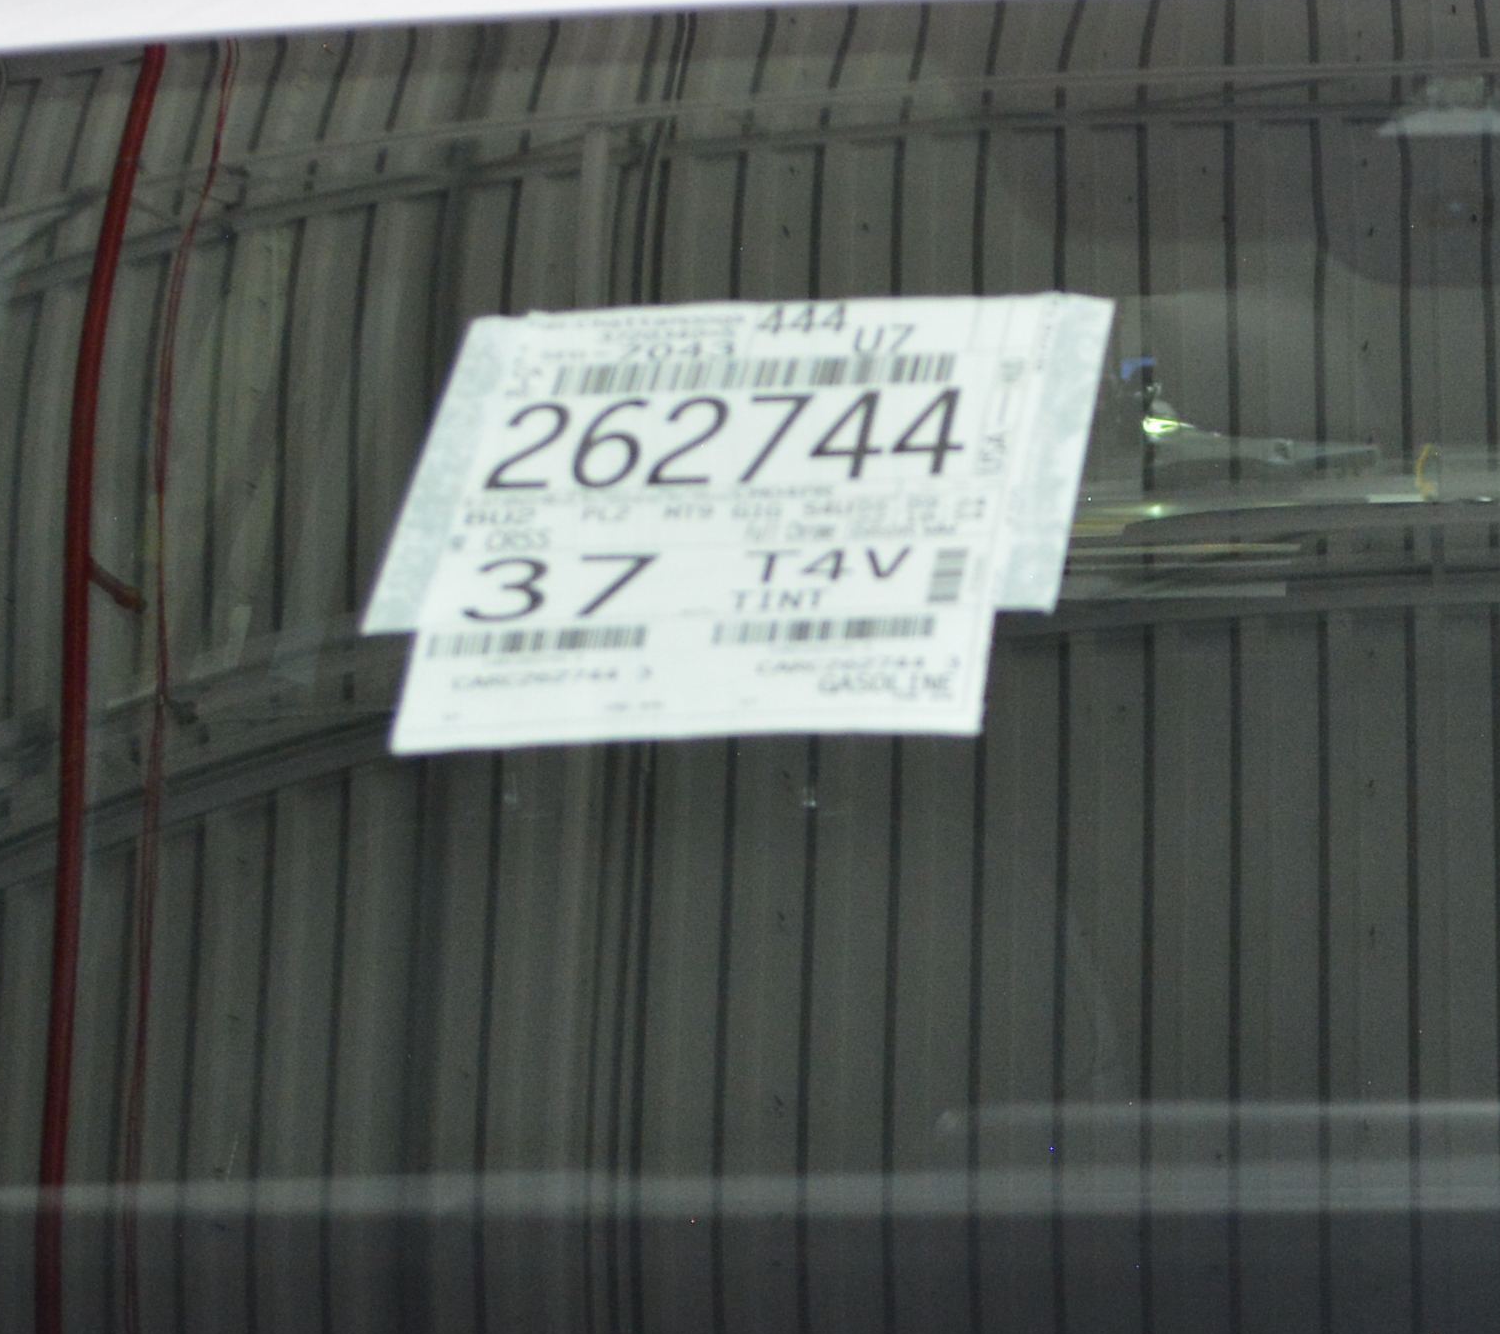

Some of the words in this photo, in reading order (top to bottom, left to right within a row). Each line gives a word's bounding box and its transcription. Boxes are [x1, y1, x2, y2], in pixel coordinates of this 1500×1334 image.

[756, 300, 849, 334] 444
[483, 384, 966, 494] 262744
[462, 551, 661, 623] 37
[744, 545, 916, 585] T4V
[731, 587, 827, 612] TINT
[817, 670, 955, 696] GASOLINE
